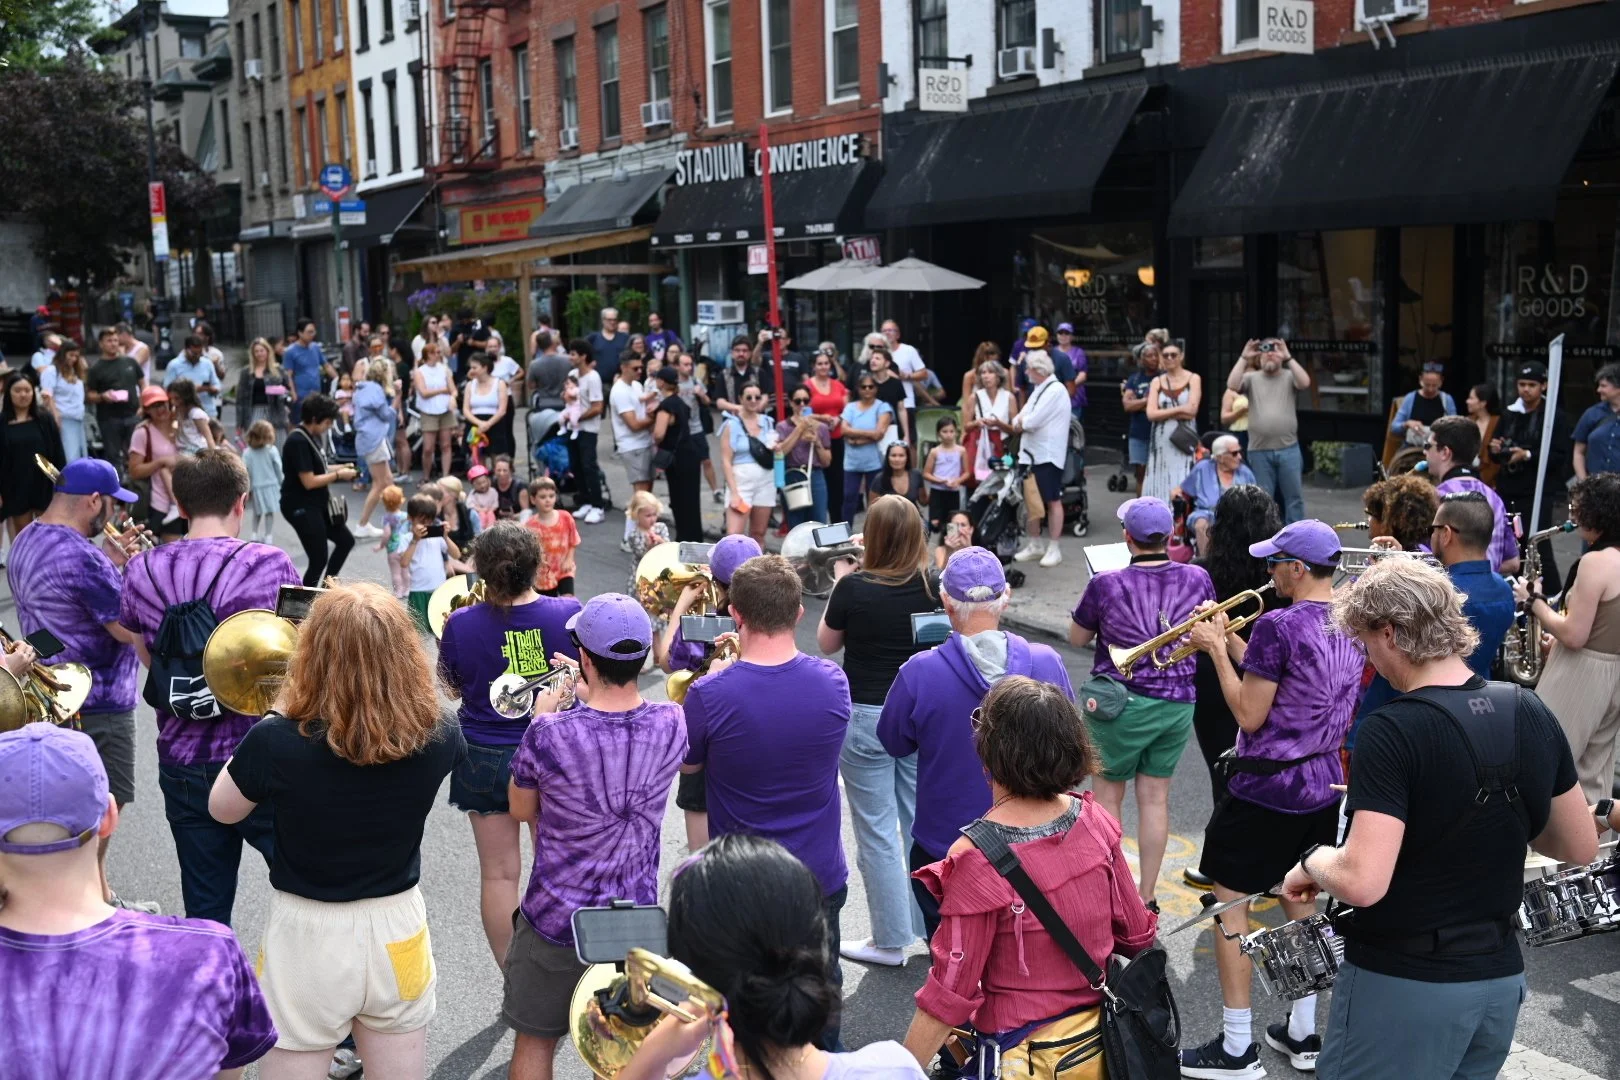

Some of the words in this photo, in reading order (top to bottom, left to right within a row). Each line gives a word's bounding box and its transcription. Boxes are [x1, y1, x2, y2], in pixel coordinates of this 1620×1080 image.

[1267, 6, 1307, 28] R&D
[1267, 28, 1306, 44] GOODS
[926, 75, 961, 92] R&D
[926, 92, 961, 104] FOODS
[675, 141, 744, 186] STADIUM
[1517, 264, 1588, 294] R&D
[1066, 299, 1107, 314] FOODS
[1519, 297, 1585, 317] GOODS
[1493, 346, 1521, 354] TABLE
[1573, 348, 1613, 356] GATHER
[514, 629, 545, 652] TRAIN
[518, 649, 545, 661] BRASS
[519, 659, 547, 673] BAND
